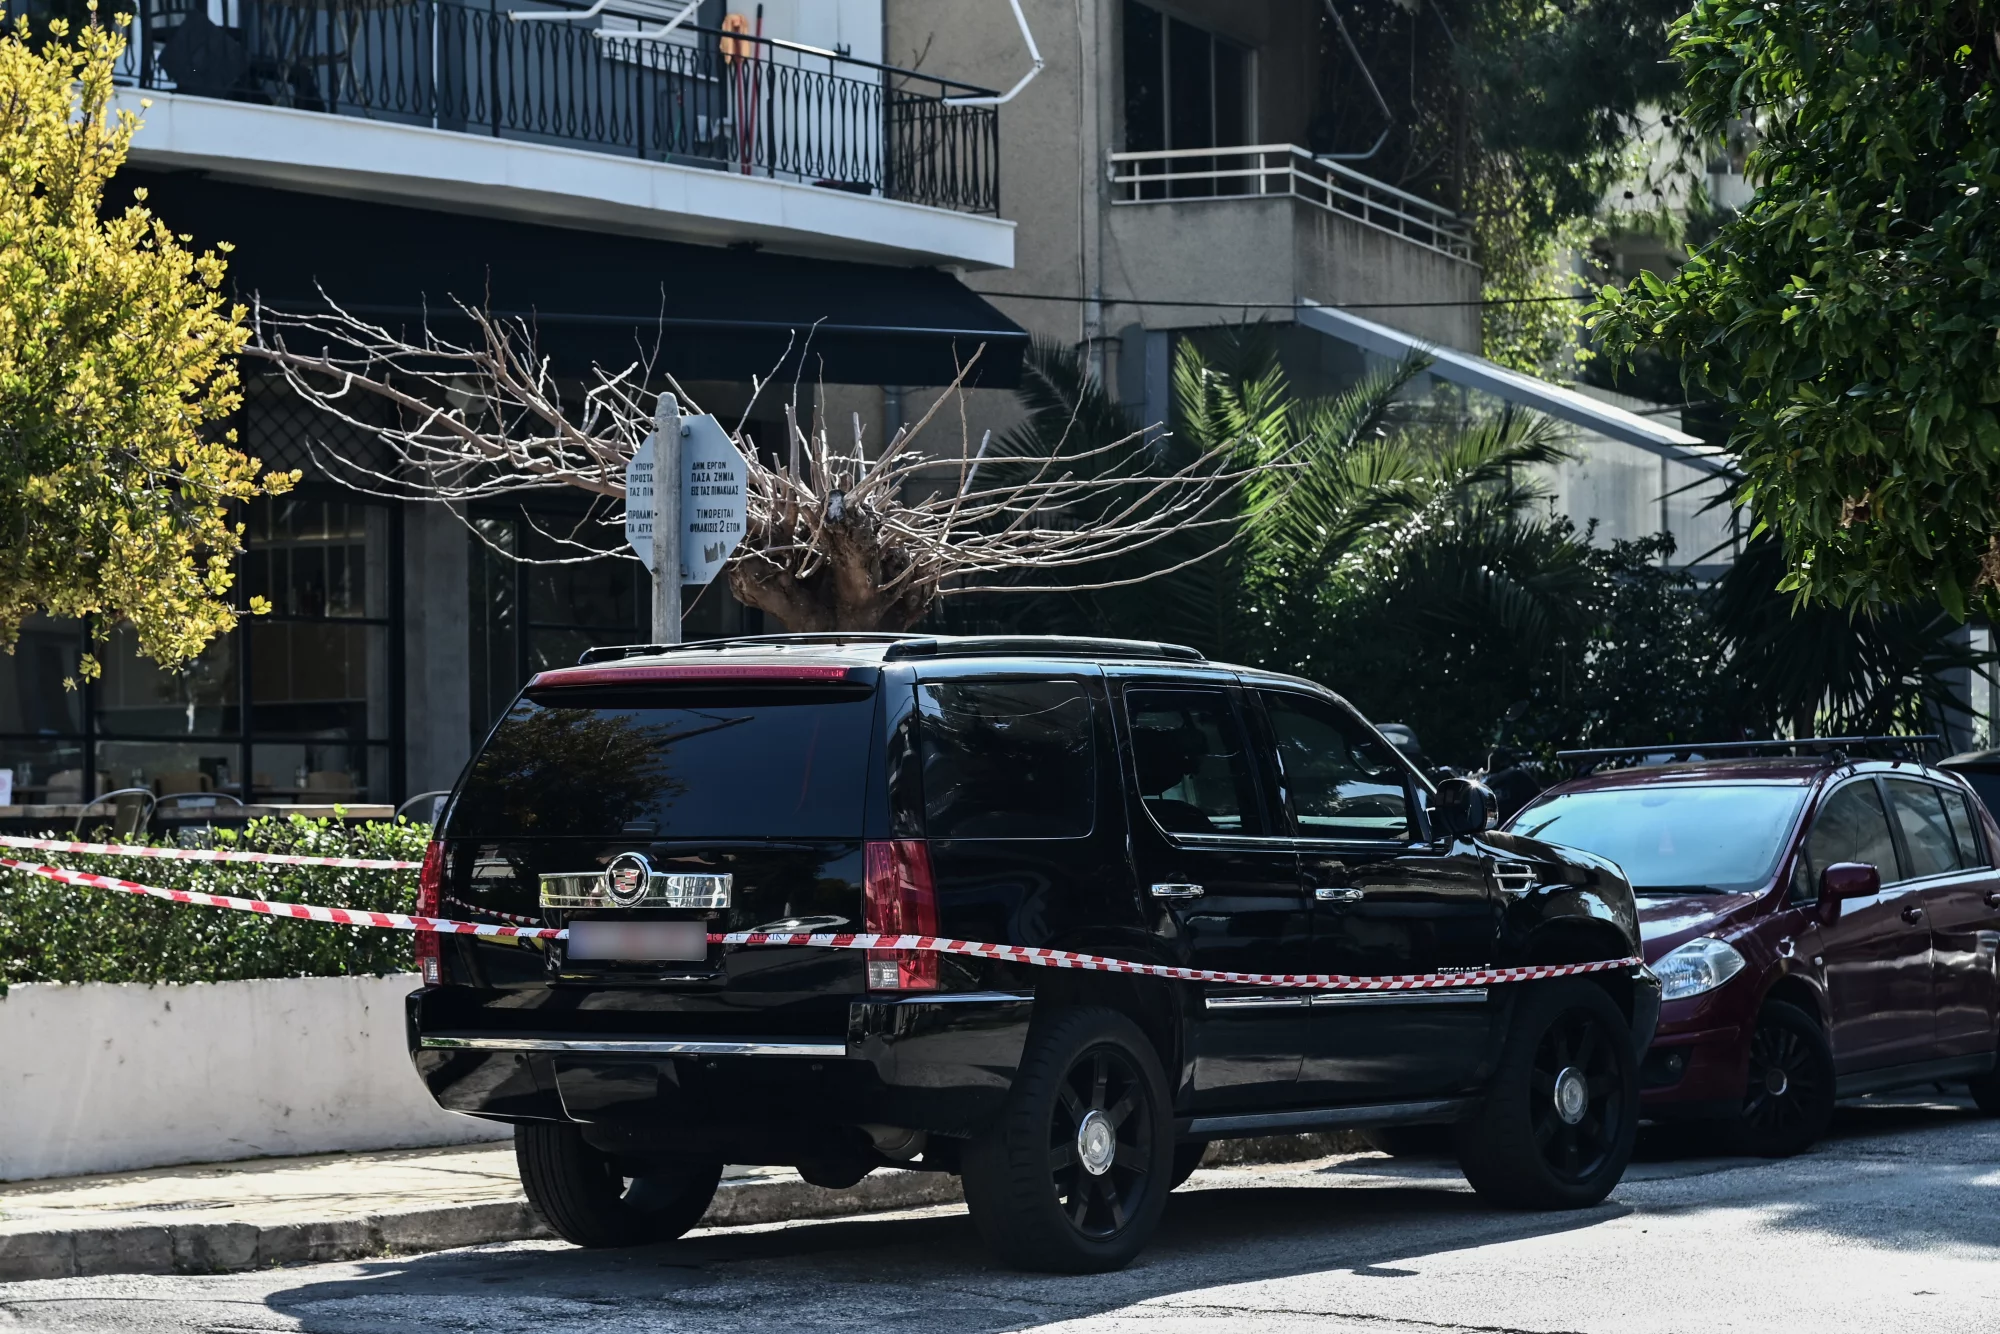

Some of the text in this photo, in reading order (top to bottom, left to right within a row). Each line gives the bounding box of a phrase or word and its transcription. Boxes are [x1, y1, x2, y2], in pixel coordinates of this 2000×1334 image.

[630, 471, 734, 483] ΠΡΟΣΤΑ ΠΑΣΑ ΖΗΜΙΑ
[629, 487, 640, 497] ΤΑΣ
[642, 487, 654, 496] ΠΙΝ
[700, 486, 710, 496] ΤΑΣ
[628, 510, 653, 519] ΠΡΟΛΑΜ
[628, 523, 635, 533] ΤΑ
[638, 523, 653, 533] ΑΤΥΧ
[719, 519, 725, 533] 2
